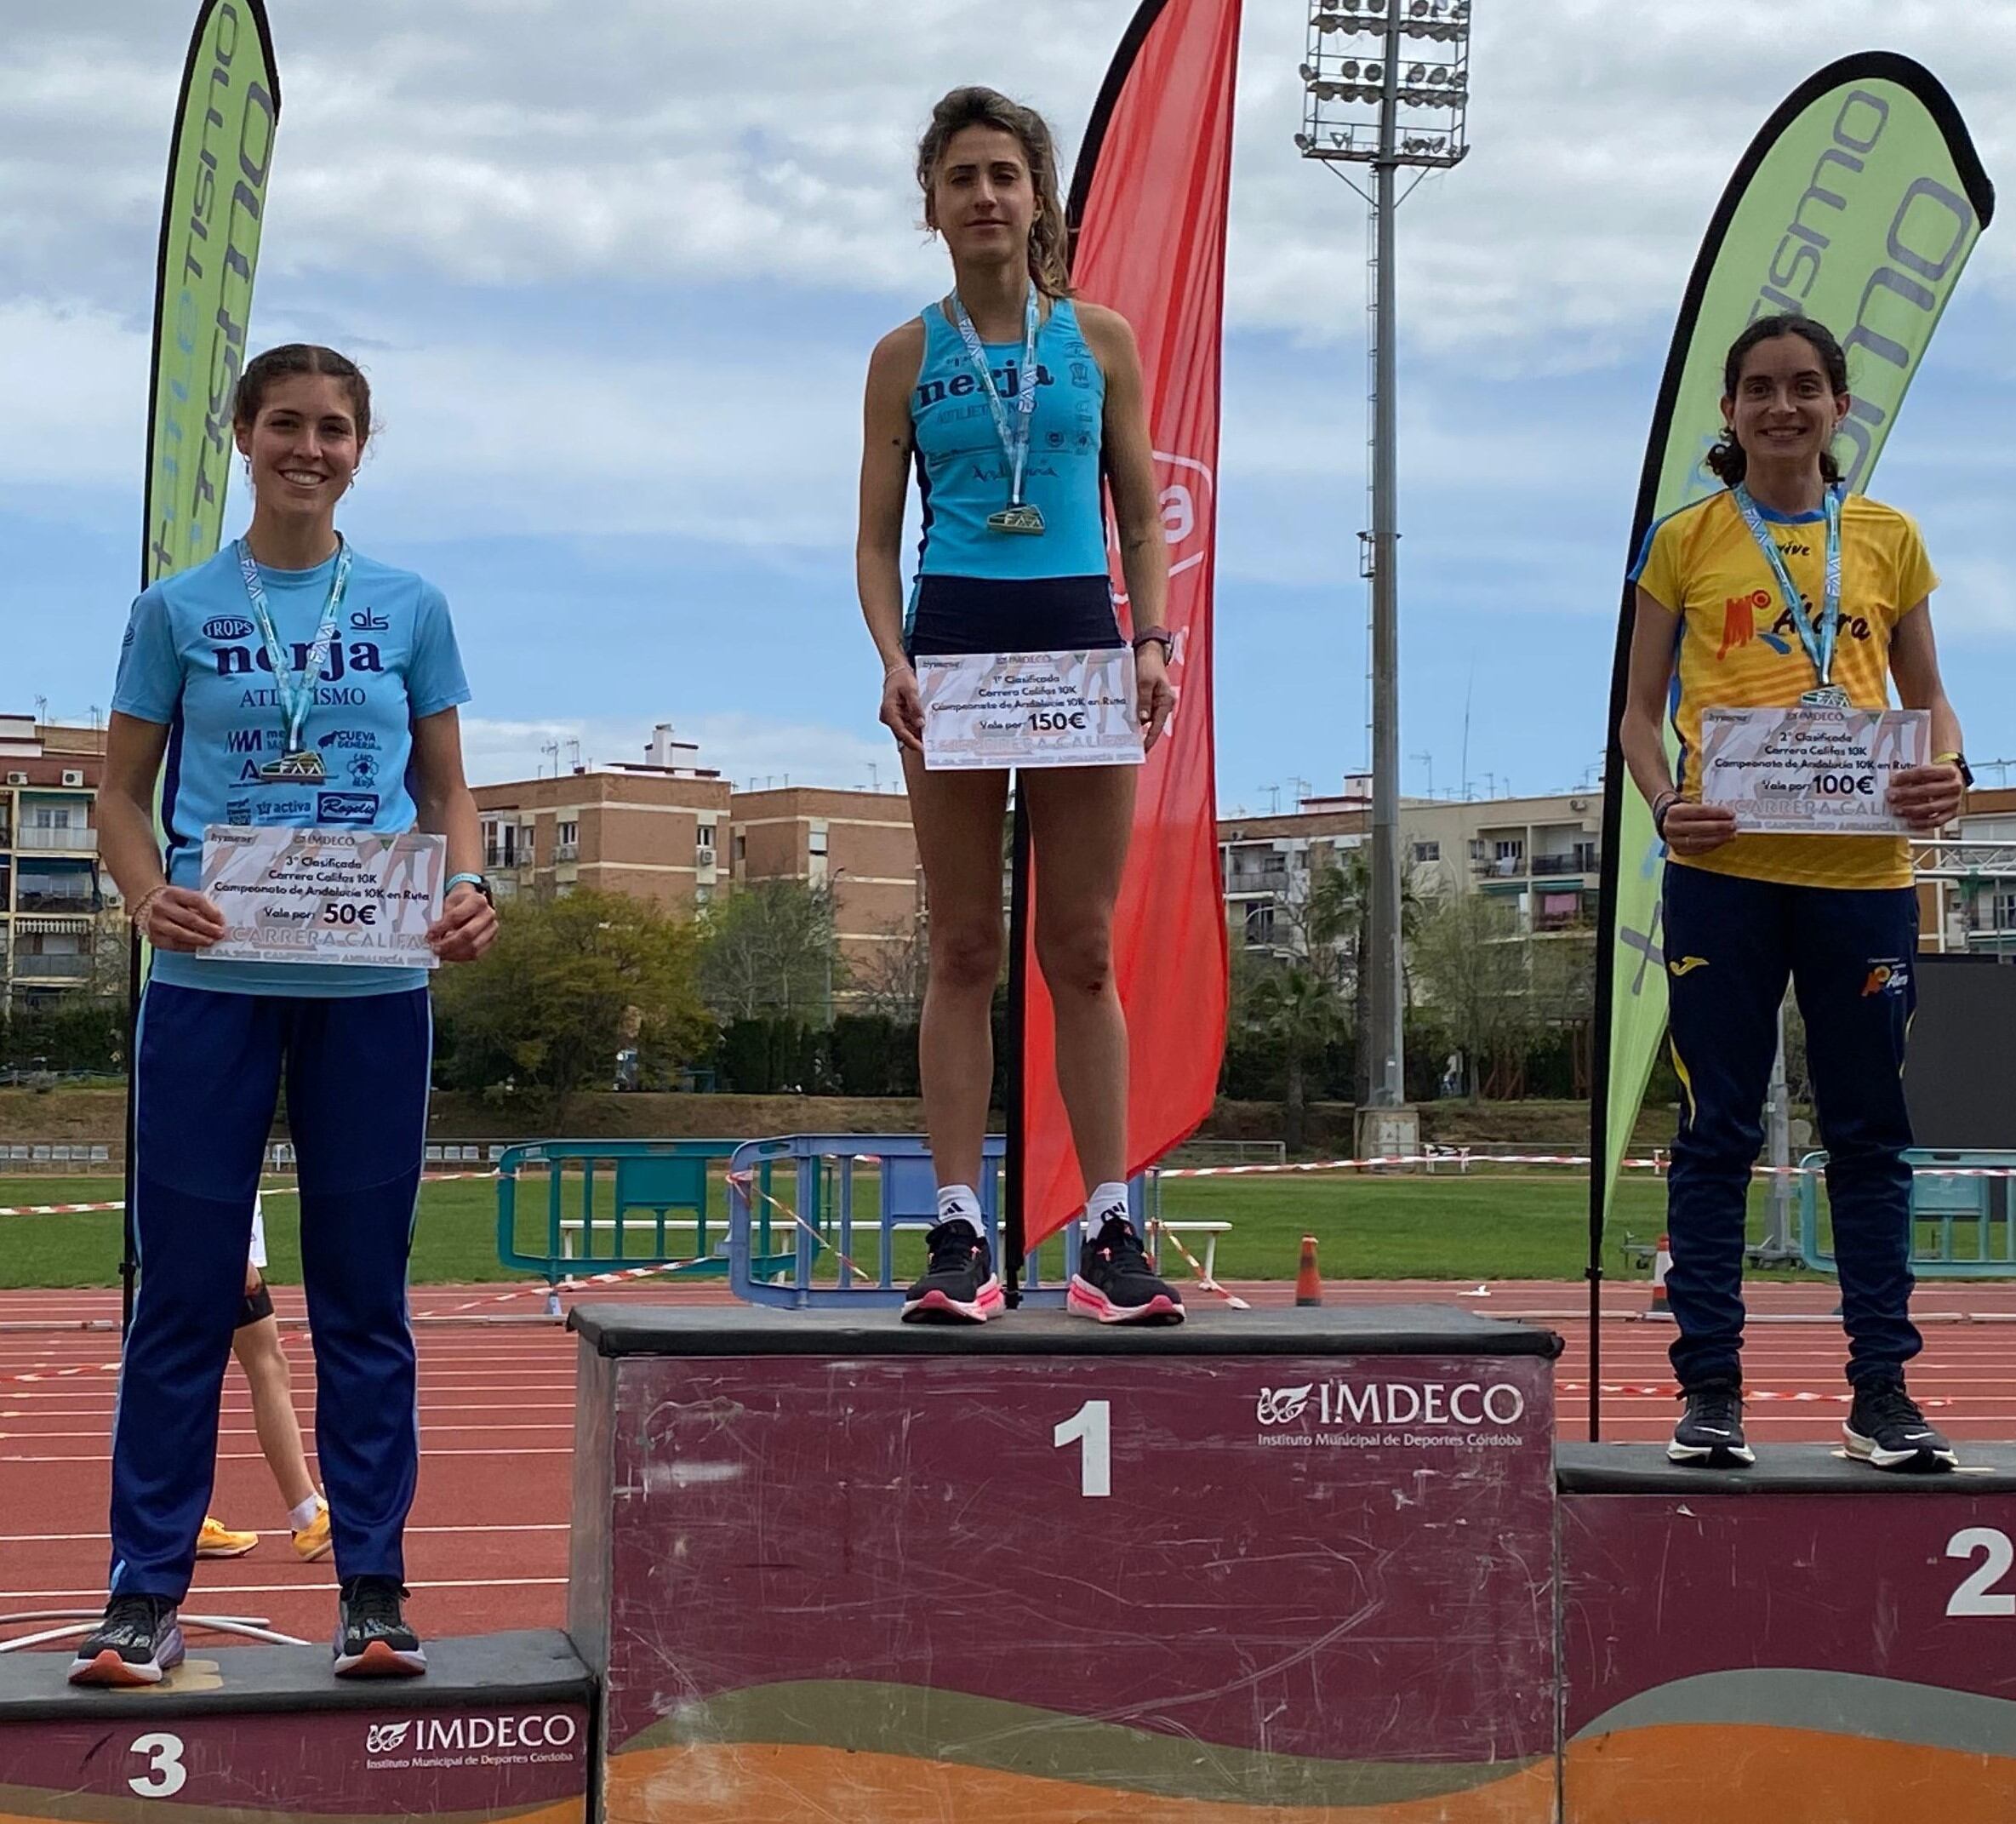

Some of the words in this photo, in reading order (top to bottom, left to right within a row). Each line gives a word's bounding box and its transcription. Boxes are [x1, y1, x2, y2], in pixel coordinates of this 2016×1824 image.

[917, 359, 1055, 408] neja
[1772, 593, 1871, 641] Áora
[239, 687, 366, 707] ATLISMO
[1028, 712, 1087, 731] 150€
[1765, 746, 1808, 756] Carrera
[1813, 775, 1875, 795] 100€
[269, 870, 314, 882] Carrera
[264, 906, 289, 918] Vale
[323, 903, 377, 925] 50€
[1054, 1400, 1111, 1497] 1
[1319, 1382, 1524, 1426] IMDECO
[1258, 1433, 1312, 1446] Instituto
[1315, 1432, 1380, 1449] Municipal
[1383, 1432, 1401, 1446] de
[1404, 1433, 1464, 1449] Deportes
[1465, 1432, 1522, 1446] Córdoba
[1945, 1527, 2016, 1616] 2
[128, 1733, 186, 1798] 3
[416, 1715, 576, 1751] IMDECO
[367, 1758, 409, 1770] Instituto
[412, 1756, 462, 1769] Municipal
[465, 1755, 478, 1766] de
[480, 1754, 528, 1767] Deportes
[530, 1752, 574, 1764] Córdoba
